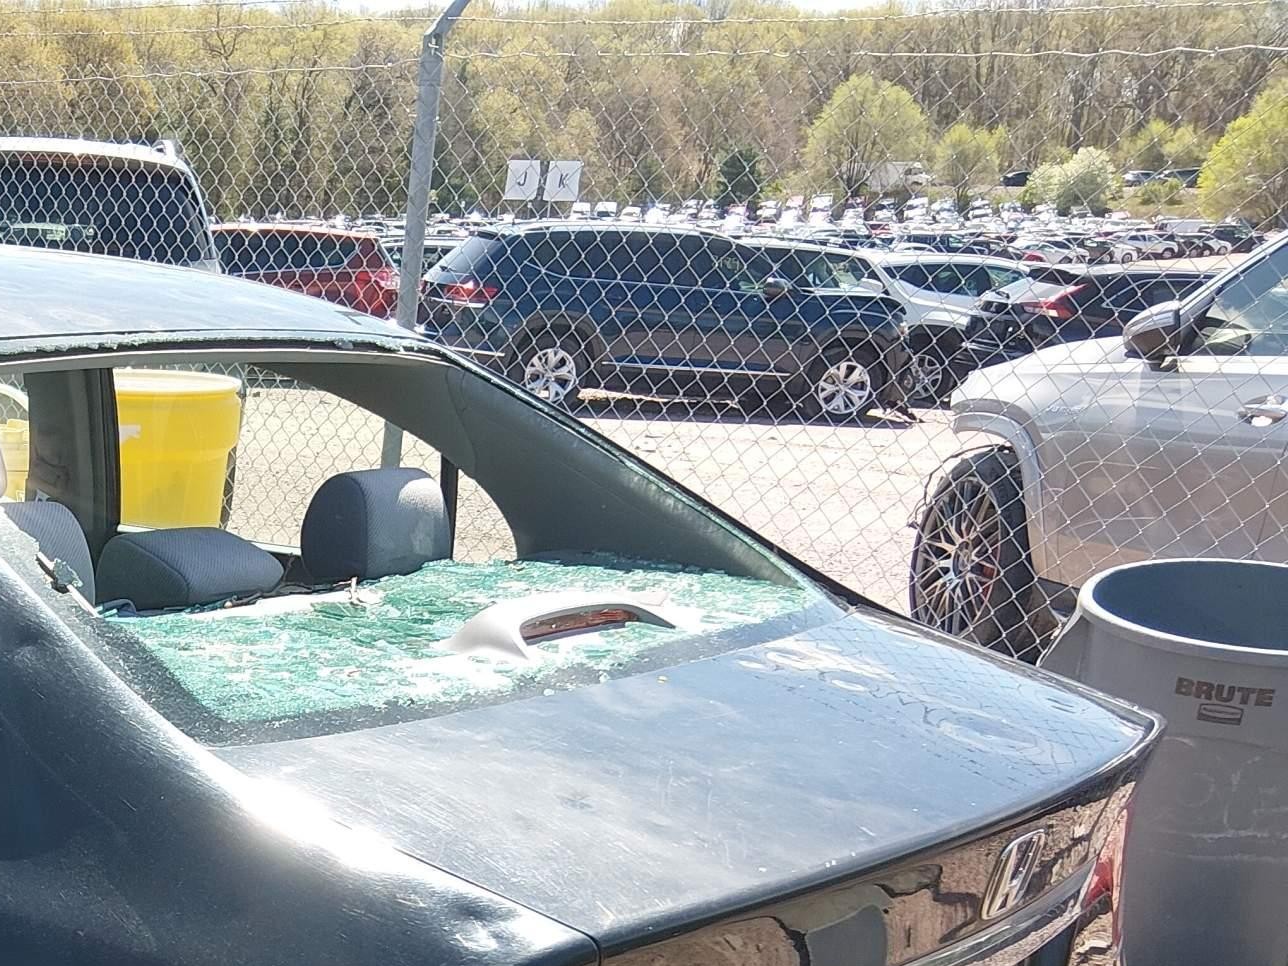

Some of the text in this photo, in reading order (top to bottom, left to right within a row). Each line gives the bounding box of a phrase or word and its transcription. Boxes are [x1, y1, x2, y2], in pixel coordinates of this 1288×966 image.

[517, 171, 527, 187] J
[558, 173, 569, 188] K
[1175, 676, 1276, 707] BRUTE
